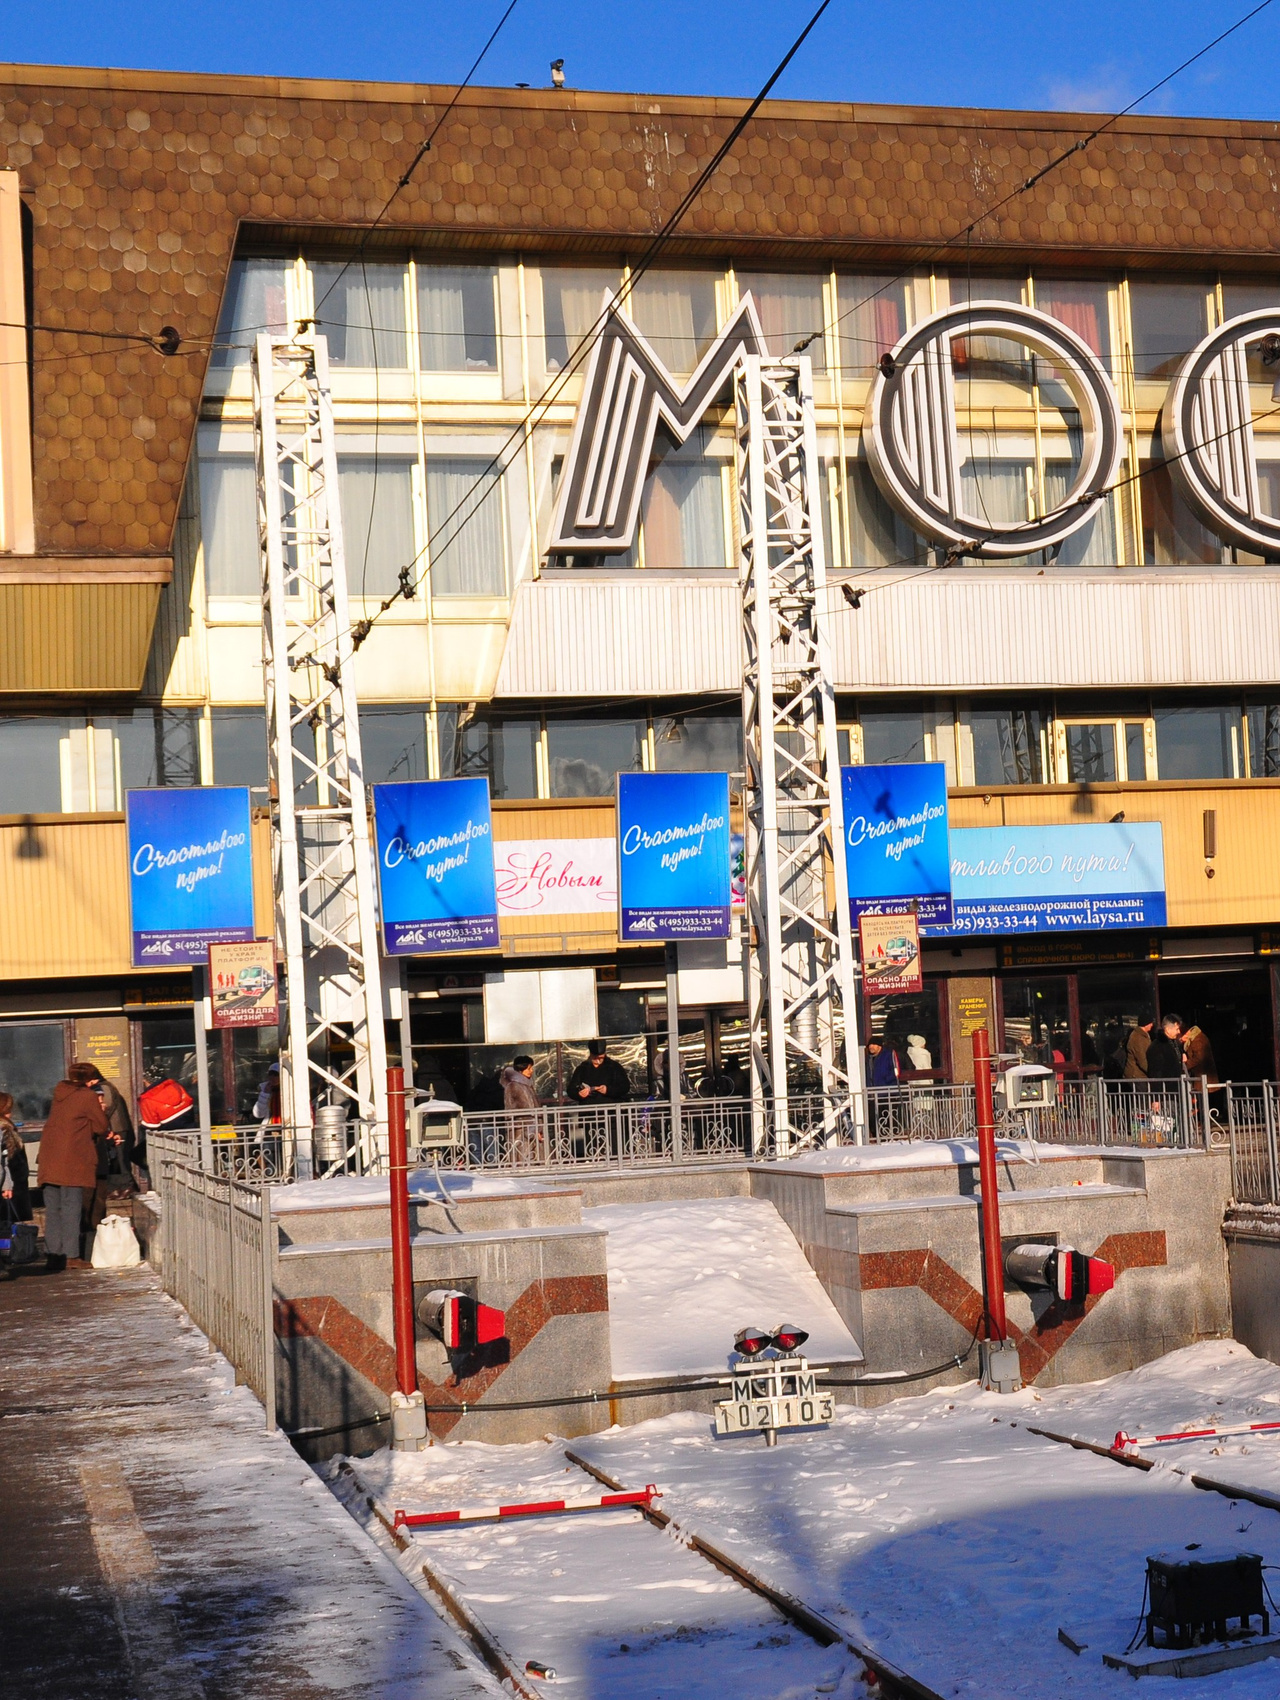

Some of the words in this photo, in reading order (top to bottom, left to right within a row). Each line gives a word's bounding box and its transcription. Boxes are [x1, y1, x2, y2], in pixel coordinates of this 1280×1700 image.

[622, 812, 724, 855] Счастливого
[848, 802, 945, 846] Счастливого
[132, 829, 245, 876] Счастливого
[384, 820, 489, 868] Счастливого
[661, 834, 704, 873] пути!
[886, 824, 926, 861] пути!
[176, 853, 224, 892] пути!
[426, 842, 469, 883] пути!
[500, 851, 603, 900] Новым
[950, 844, 1053, 877] тливого
[1060, 843, 1136, 883] пути!
[957, 904, 986, 915] виды
[988, 898, 1090, 915] железнодорожной
[1093, 899, 1144, 912] рекламы:
[1046, 910, 1144, 928] www.laysa.ru
[427, 926, 494, 939] 8(495)933-33-44
[659, 917, 723, 927] 8(495)933-33-44
[671, 925, 712, 933] www.laysa.ru
[867, 975, 900, 984] ОПАСНО
[878, 981, 909, 989] ЖИЗНИ!
[217, 1007, 254, 1016] ОПАСНО
[255, 1007, 274, 1015] ДЛЯ
[734, 1380, 750, 1401] М
[799, 1375, 814, 1397] М
[721, 1403, 770, 1432] 102
[785, 1399, 833, 1422] 103
